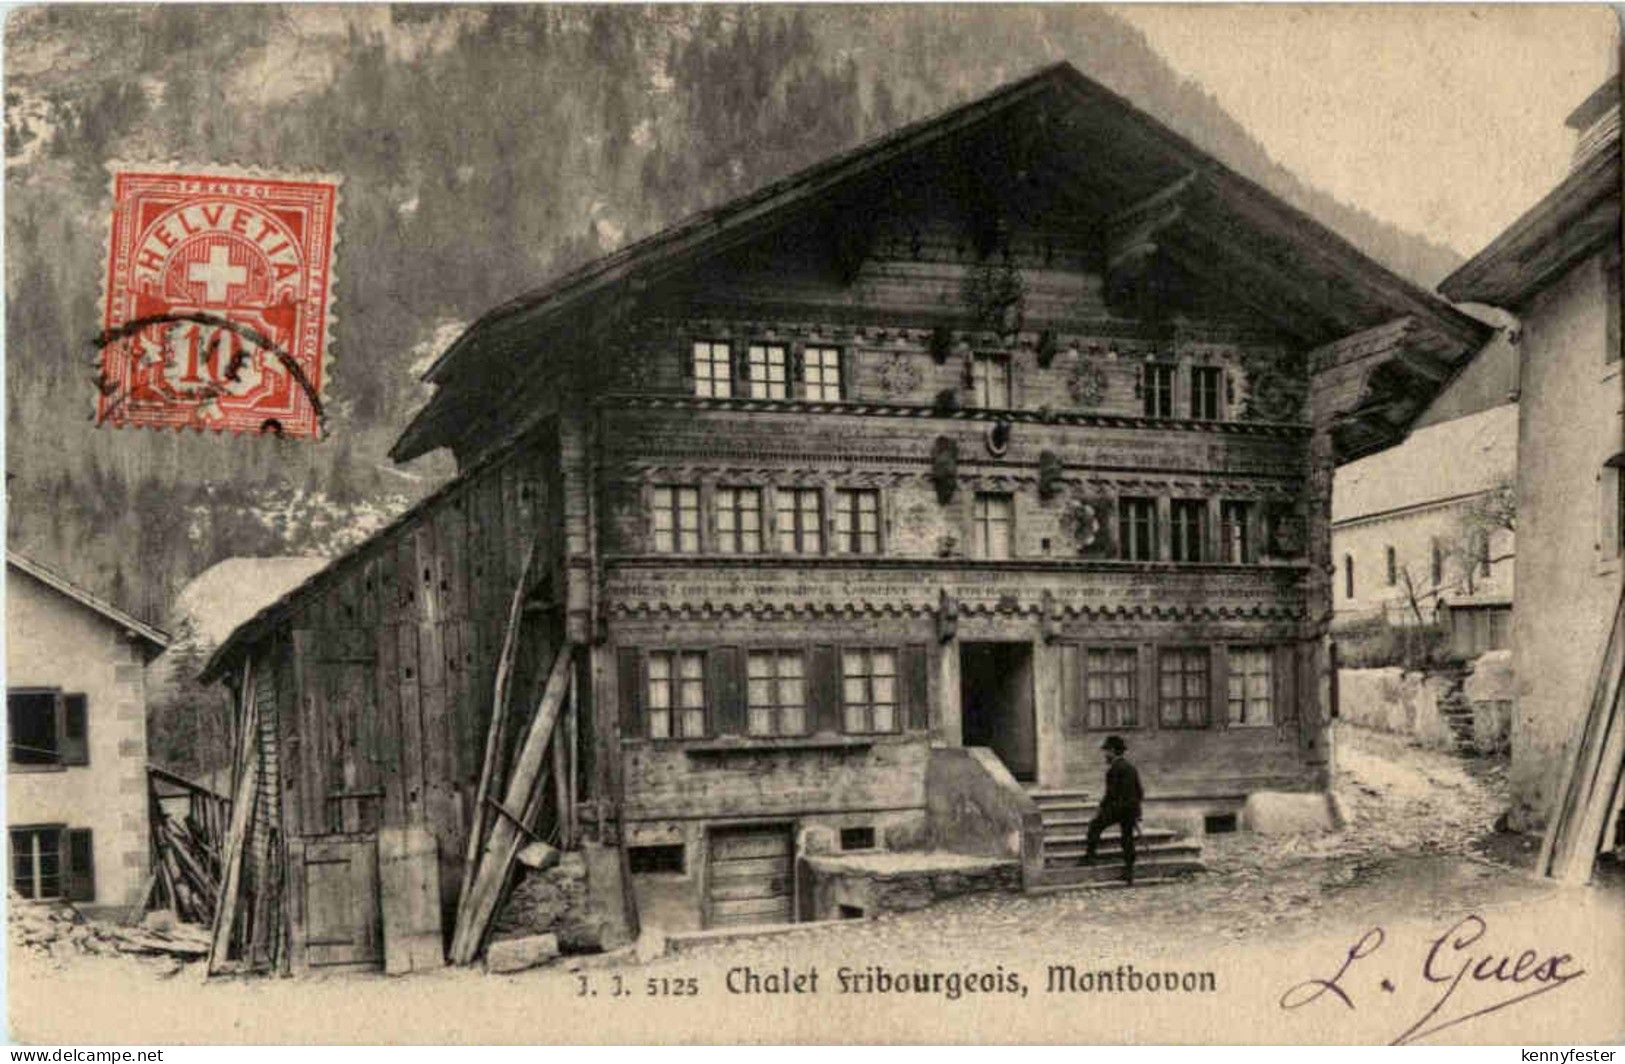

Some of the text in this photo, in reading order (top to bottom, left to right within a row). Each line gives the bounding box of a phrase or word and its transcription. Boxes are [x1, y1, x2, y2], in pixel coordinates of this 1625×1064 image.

[136, 204, 300, 282] HELVETIA
[179, 323, 243, 384] 10
[646, 977, 700, 996] 5125
[725, 965, 820, 995] Chalet
[837, 965, 1030, 1000] Fribourgeois,
[1046, 964, 1217, 993] Montbovon
